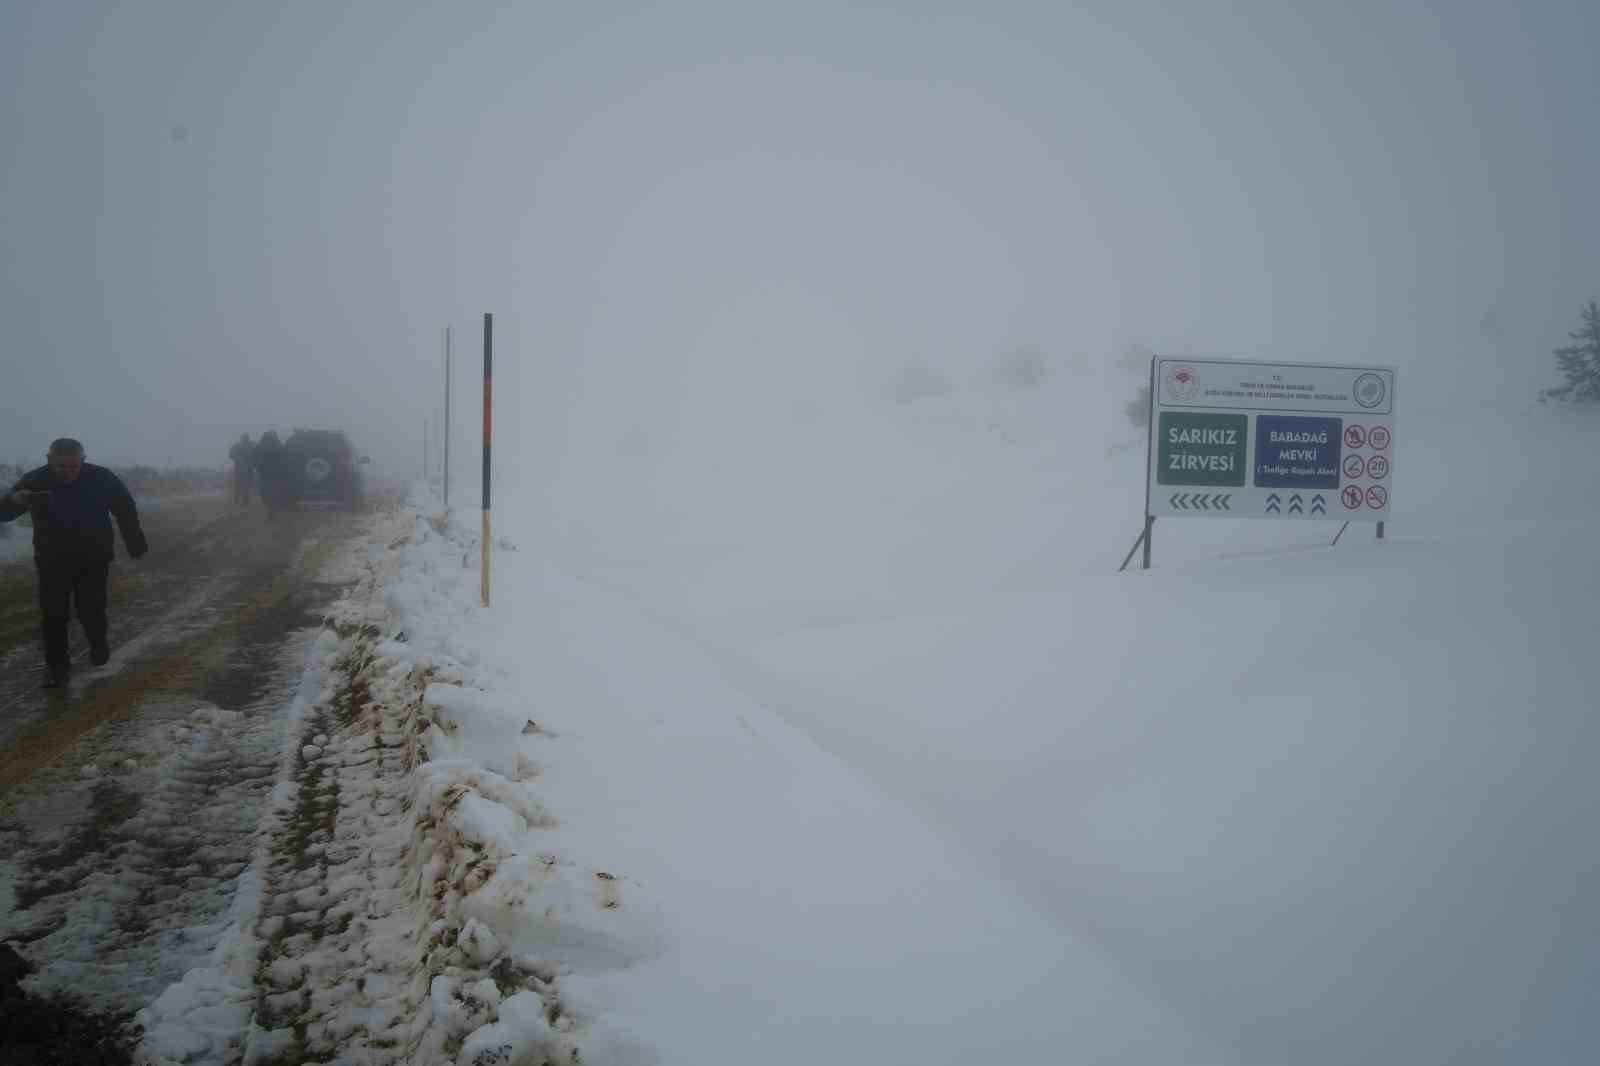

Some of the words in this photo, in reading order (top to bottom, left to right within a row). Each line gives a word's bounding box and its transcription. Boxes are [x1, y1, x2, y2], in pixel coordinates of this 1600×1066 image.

[1168, 427, 1237, 445] SARIKIZ
[1270, 430, 1328, 444] BABADAĞ
[1168, 450, 1235, 472] ZİRVESİ
[1279, 448, 1318, 461] MEVKİ
